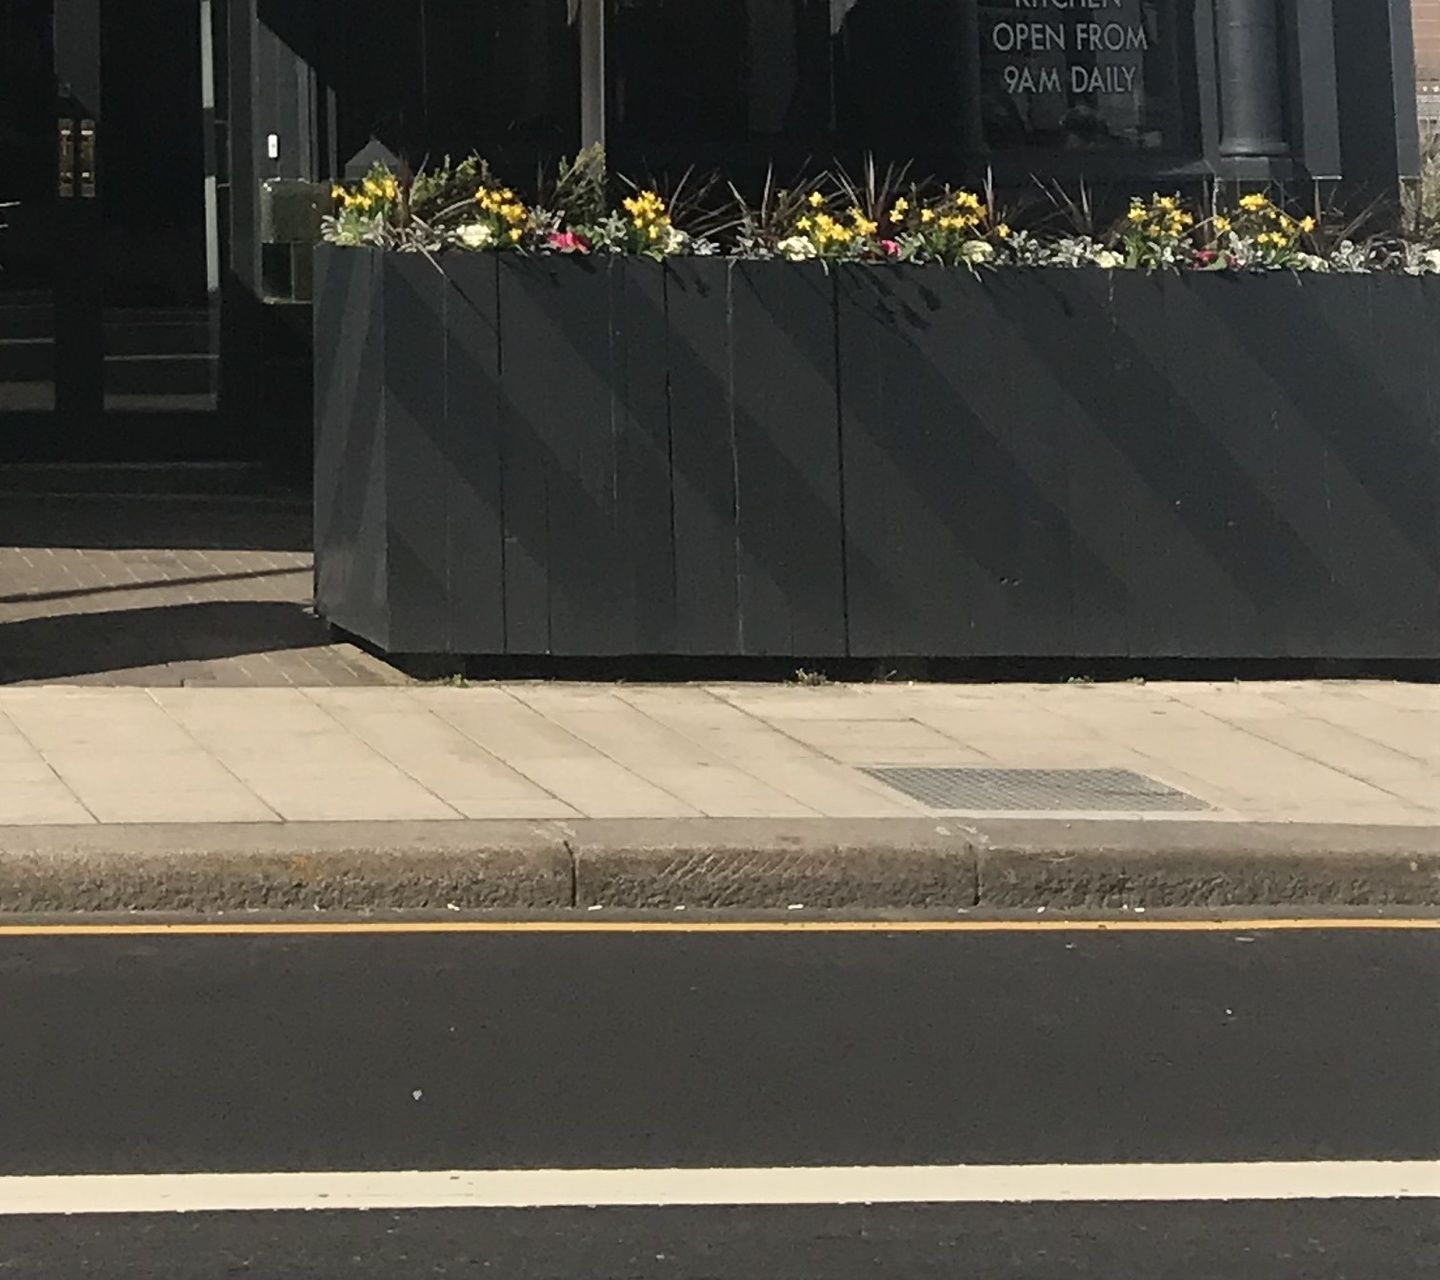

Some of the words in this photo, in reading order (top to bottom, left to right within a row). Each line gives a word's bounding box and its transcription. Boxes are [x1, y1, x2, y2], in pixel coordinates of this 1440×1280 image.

[993, 23, 1064, 52] OPEN
[1077, 23, 1148, 51] FROM
[1004, 66, 1061, 95] 9AM
[1072, 66, 1136, 94] DAILY
